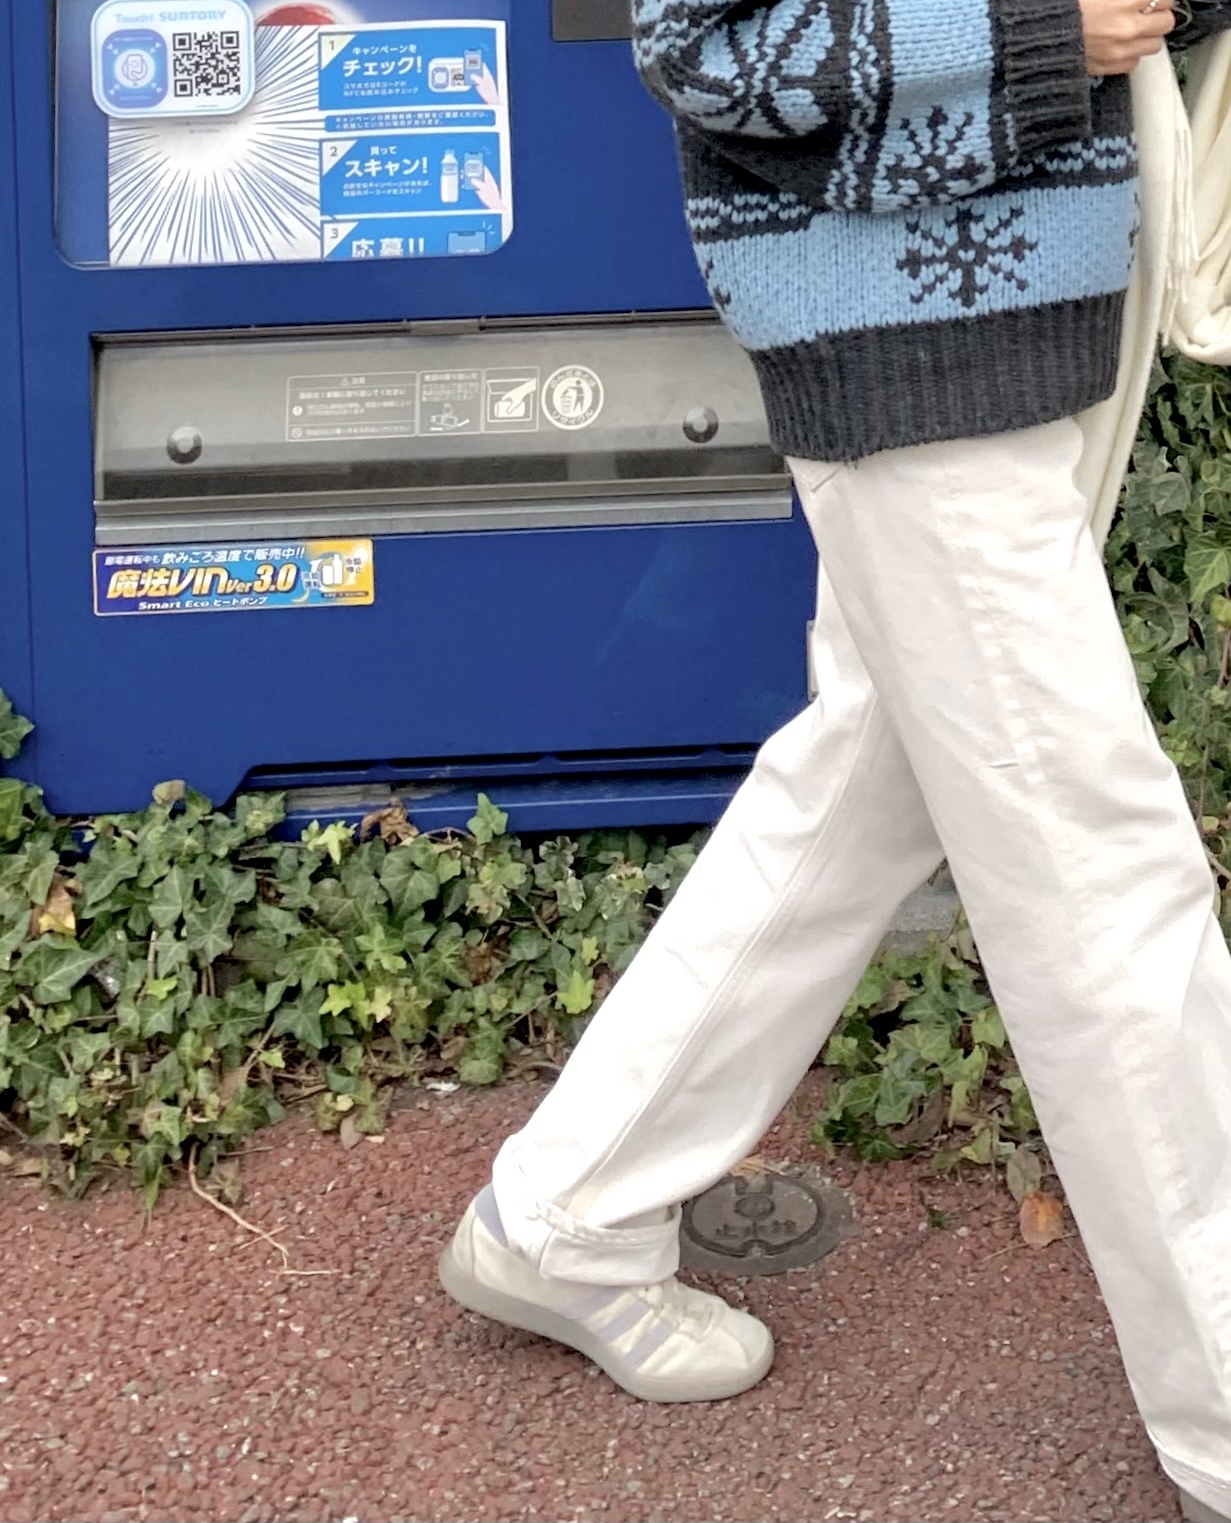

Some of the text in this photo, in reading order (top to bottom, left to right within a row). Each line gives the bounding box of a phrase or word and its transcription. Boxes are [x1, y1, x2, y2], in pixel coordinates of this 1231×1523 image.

[328, 40, 336, 51] 1
[352, 43, 417, 57] キャンペーンを
[342, 55, 423, 78] チェック!
[329, 145, 339, 158] 2
[369, 145, 398, 157] 買って
[344, 156, 428, 179] スキャン!
[329, 227, 340, 240] 3
[251, 563, 297, 594] 3.0
[138, 596, 269, 610] Smart Eco ヒートポンプ
